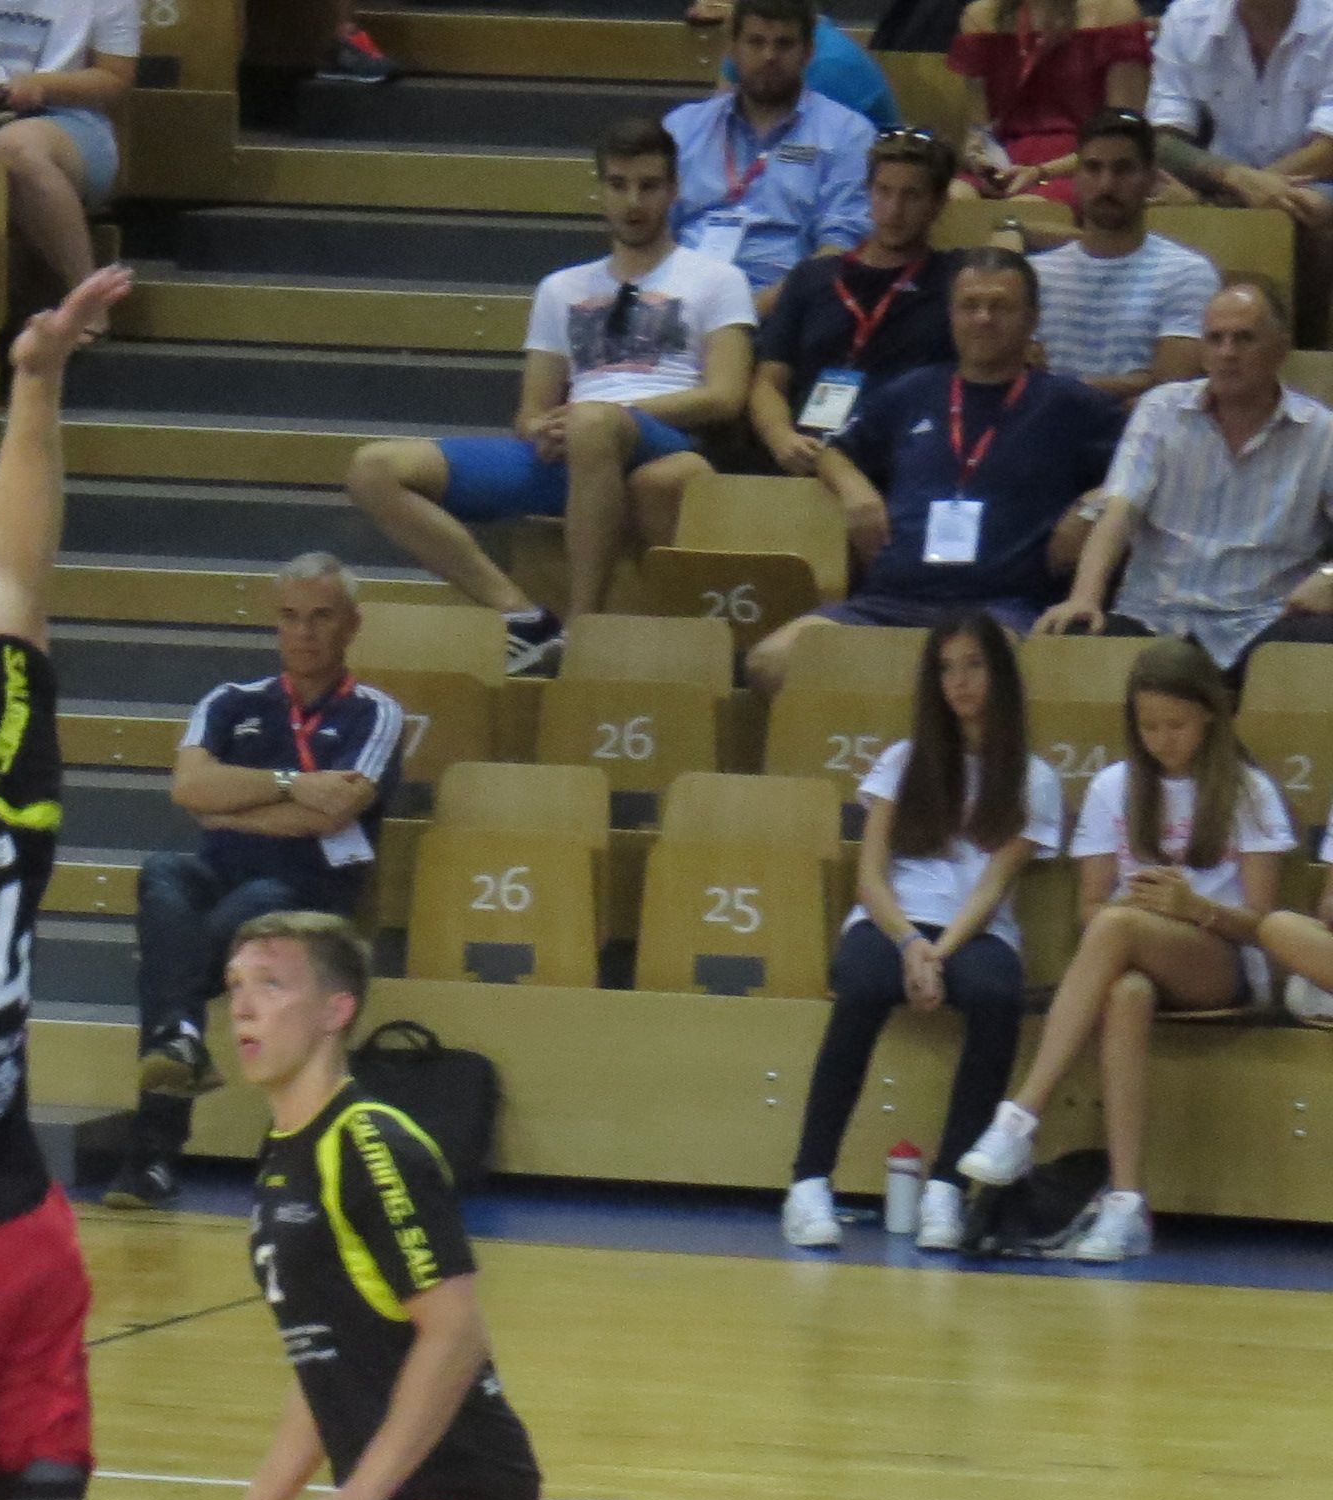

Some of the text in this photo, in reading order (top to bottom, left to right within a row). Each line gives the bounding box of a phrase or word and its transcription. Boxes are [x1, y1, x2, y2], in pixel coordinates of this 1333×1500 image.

[700, 584, 763, 624] 26
[591, 716, 656, 761] 26
[469, 866, 532, 912] 26
[702, 886, 763, 934] 25
